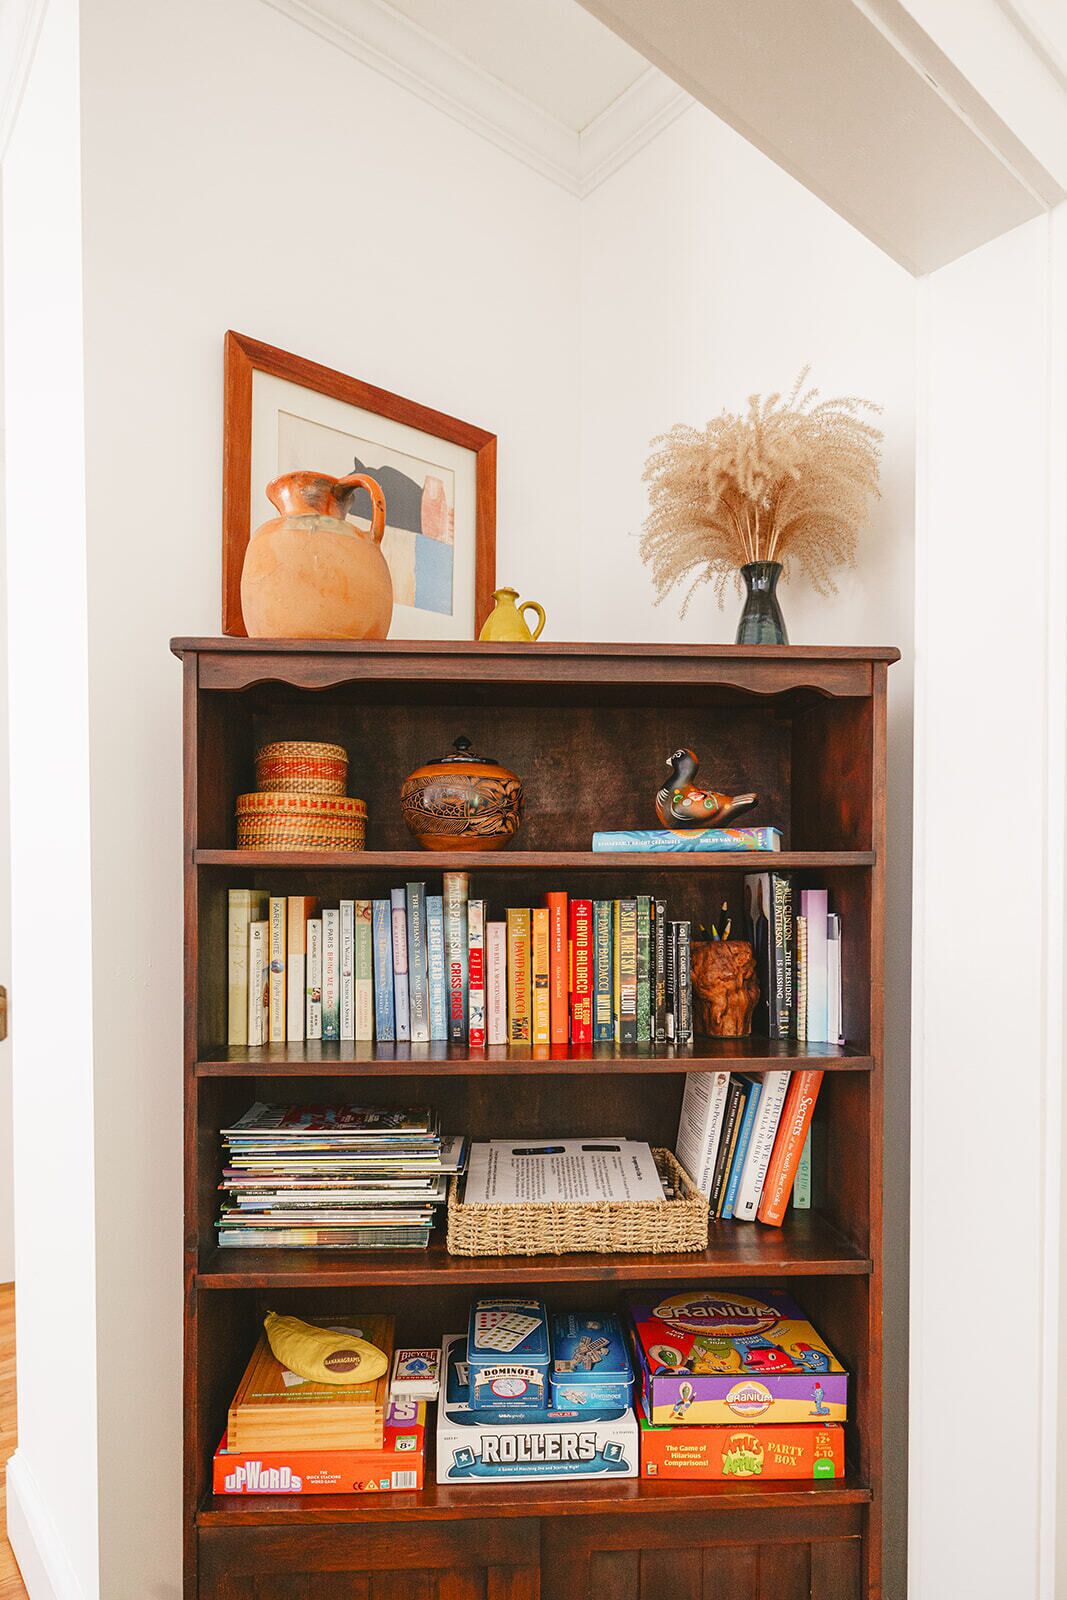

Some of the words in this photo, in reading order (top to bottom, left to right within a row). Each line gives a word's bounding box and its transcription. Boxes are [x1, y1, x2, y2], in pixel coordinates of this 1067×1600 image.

[449, 879, 462, 909] JAMES
[784, 888, 792, 905] BILL
[360, 927, 368, 939] The
[430, 918, 442, 951] BEACH
[449, 910, 462, 960] PATTERSON
[576, 919, 588, 947] DAVID
[598, 918, 609, 945] DAVID
[621, 911, 636, 933] SARA
[784, 905, 792, 941] CLINTON
[358, 940, 368, 960] Recipe
[514, 941, 525, 968] DAVID
[621, 935, 636, 975] PARETSKY
[360, 962, 368, 978] Club
[431, 954, 442, 980] READ
[450, 962, 463, 989] CRISS
[576, 950, 588, 994] BALDACCI
[598, 947, 609, 992] BALDACCI
[327, 977, 334, 987] ME
[514, 970, 525, 1013] BALDACCI
[451, 990, 463, 1020] CROSS
[597, 994, 611, 1024] DAYLIGHT
[621, 984, 636, 1014] FALLOUT
[512, 1018, 522, 1040] MAN
[777, 1070, 789, 1094] THE
[761, 1096, 773, 1131] KAMALA
[766, 1096, 782, 1141] TRUTHS
[793, 1095, 813, 1138] Secrets
[708, 1098, 722, 1156] Un-Prescription
[752, 1132, 764, 1166] HARRIS
[761, 1143, 771, 1161] WE
[781, 1151, 793, 1173] South's
[699, 1166, 711, 1192] Autism
[754, 1163, 766, 1194] HOLD
[778, 1172, 788, 1187] Best
[772, 1186, 784, 1207] Cooks
[325, 1356, 360, 1365] BANANAGRAMS
[401, 1351, 436, 1361] BICYCLE
[484, 1367, 534, 1376] DOMINOES
[400, 1442, 411, 1450] 8+
[480, 1432, 597, 1464] ROLLERS
[768, 1442, 804, 1457] PARTY
[815, 1436, 830, 1444] 12+
[664, 1459, 709, 1467] Comparisons!
[775, 1454, 797, 1466] BOX
[814, 1450, 834, 1458] 4-10
